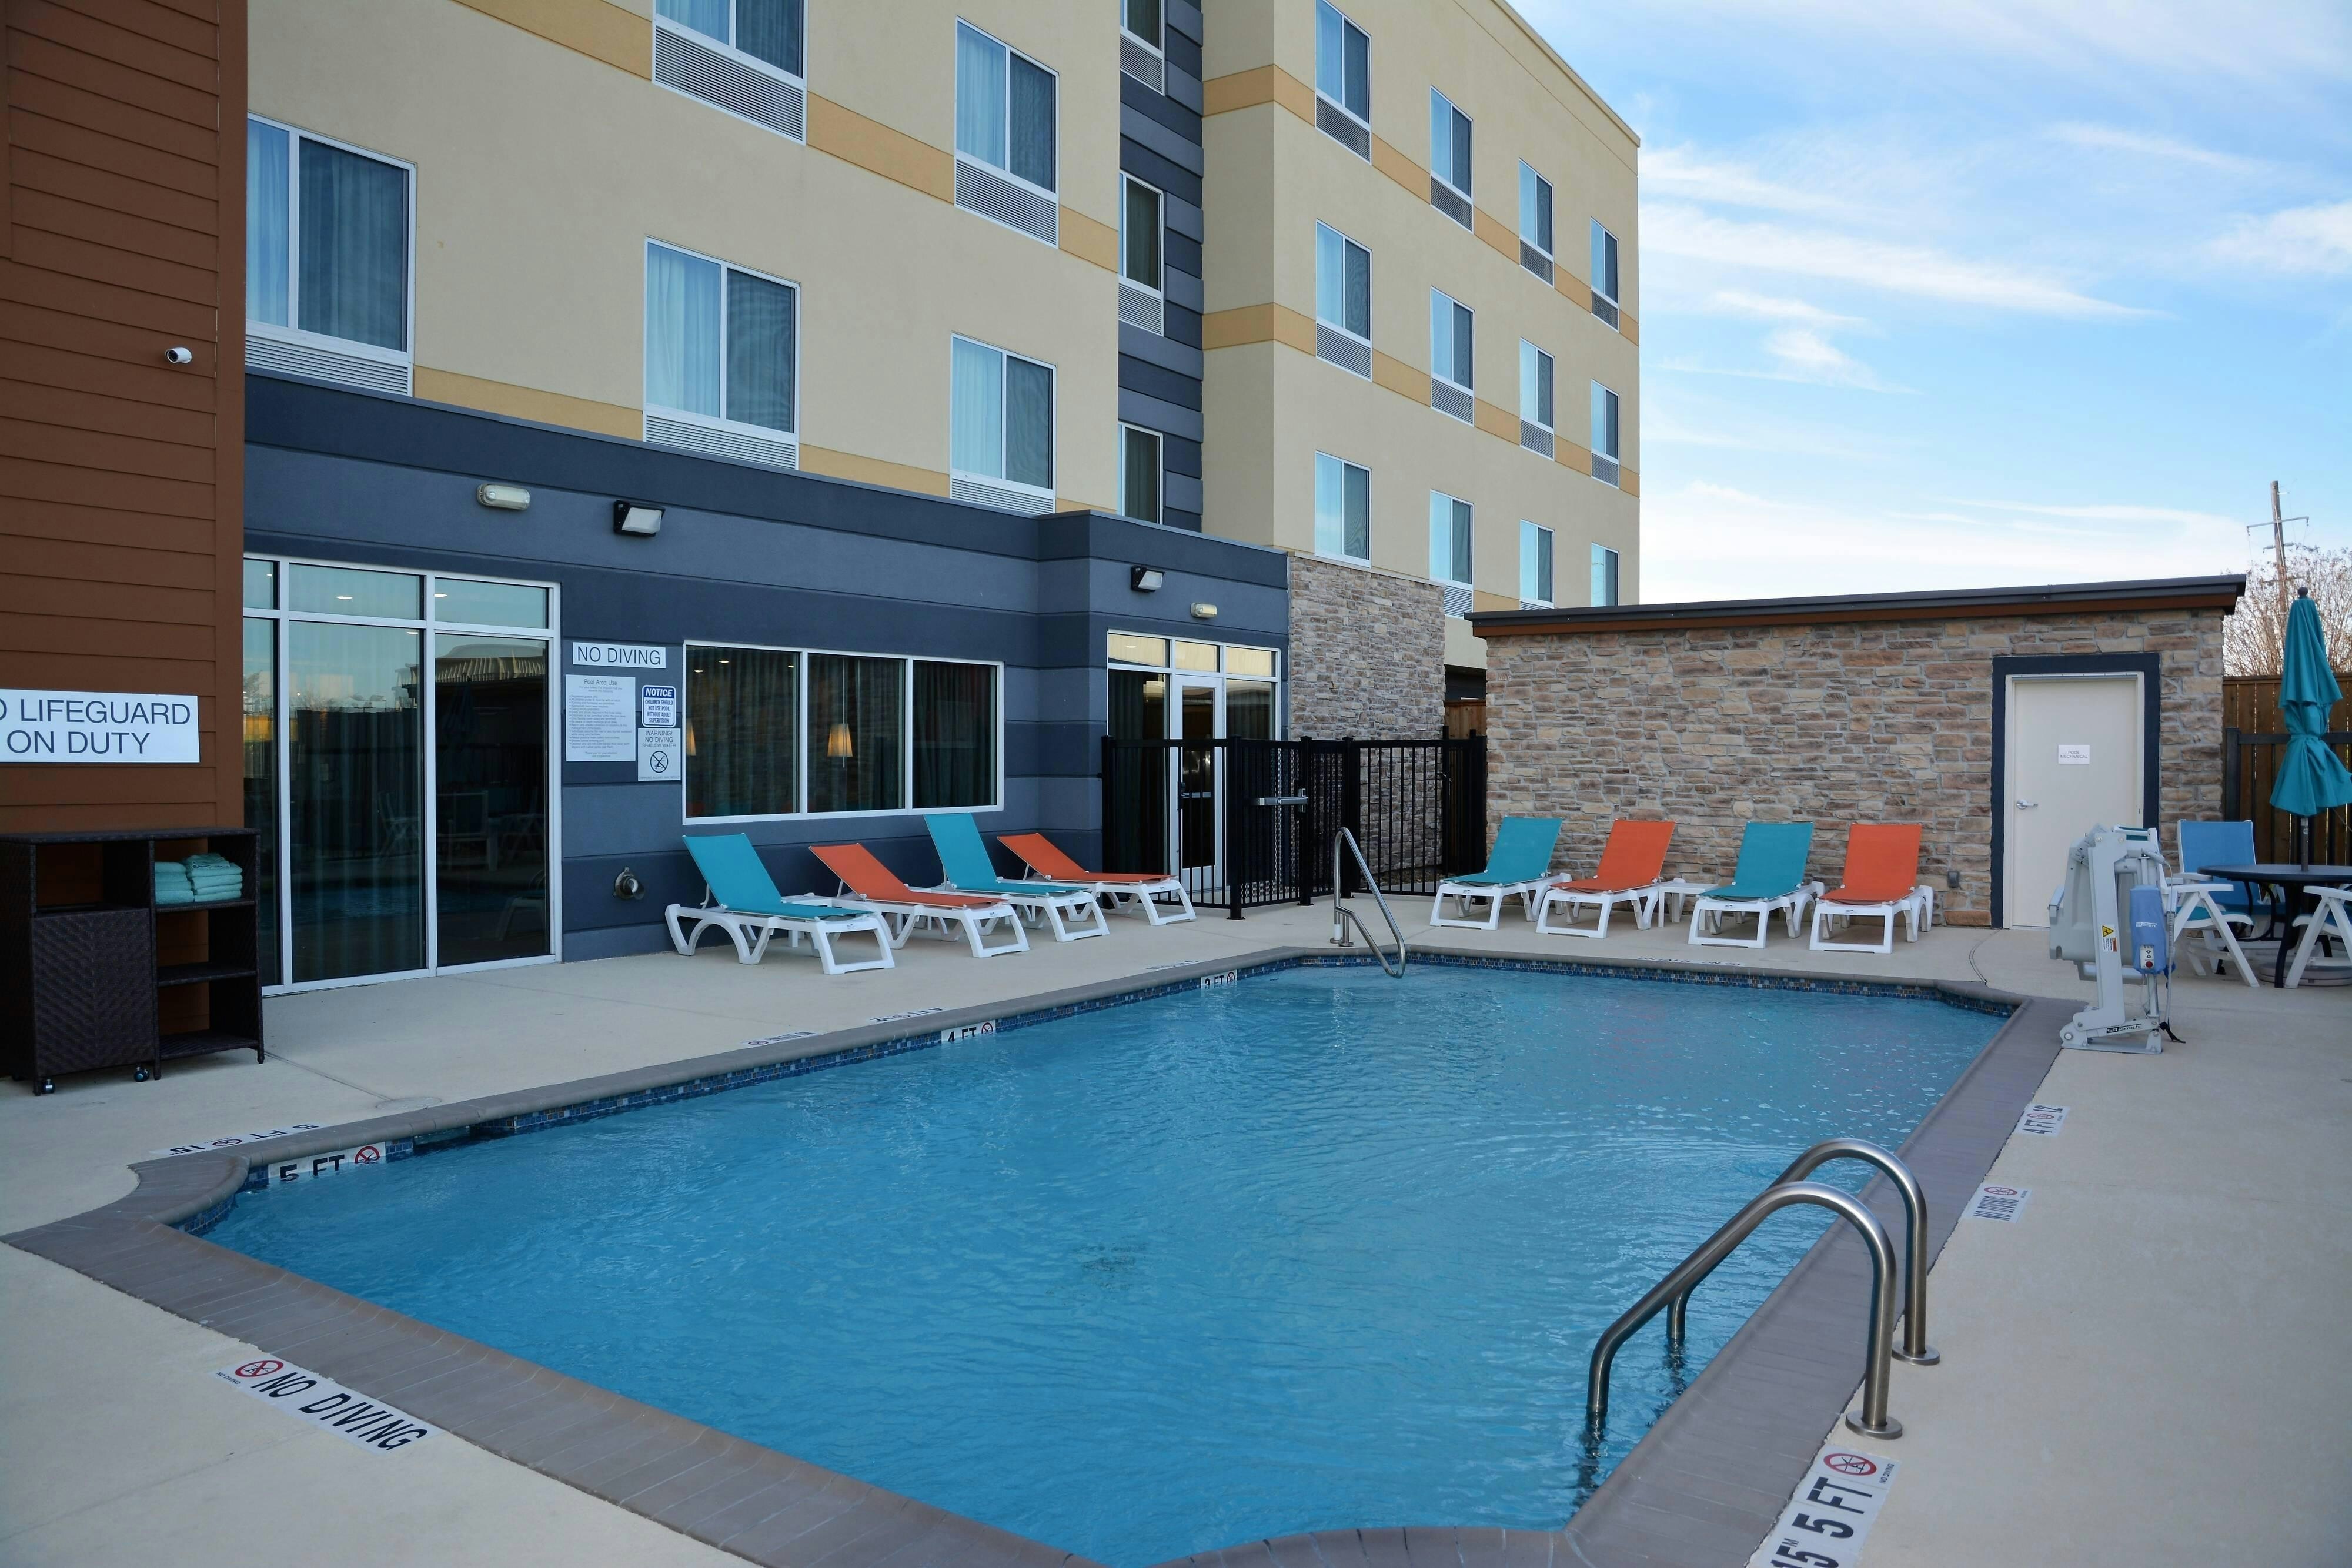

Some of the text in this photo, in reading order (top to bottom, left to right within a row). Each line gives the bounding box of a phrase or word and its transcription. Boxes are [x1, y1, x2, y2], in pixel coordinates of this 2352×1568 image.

[577, 646, 661, 665] NO DIVING
[646, 688, 673, 697] NOTICE
[21, 698, 191, 725] LIFEGUARD
[7, 730, 150, 754] ON DUTY
[249, 1129, 288, 1139] FT
[280, 1154, 345, 1181] 5 FT
[1973, 1196, 2019, 1221] NO DIVING
[250, 1372, 428, 1450] NO DIVING
[1882, 1463, 1895, 1477] DIVING
[1806, 1476, 1872, 1514] FT
[1792, 1513, 1854, 1539] 5
